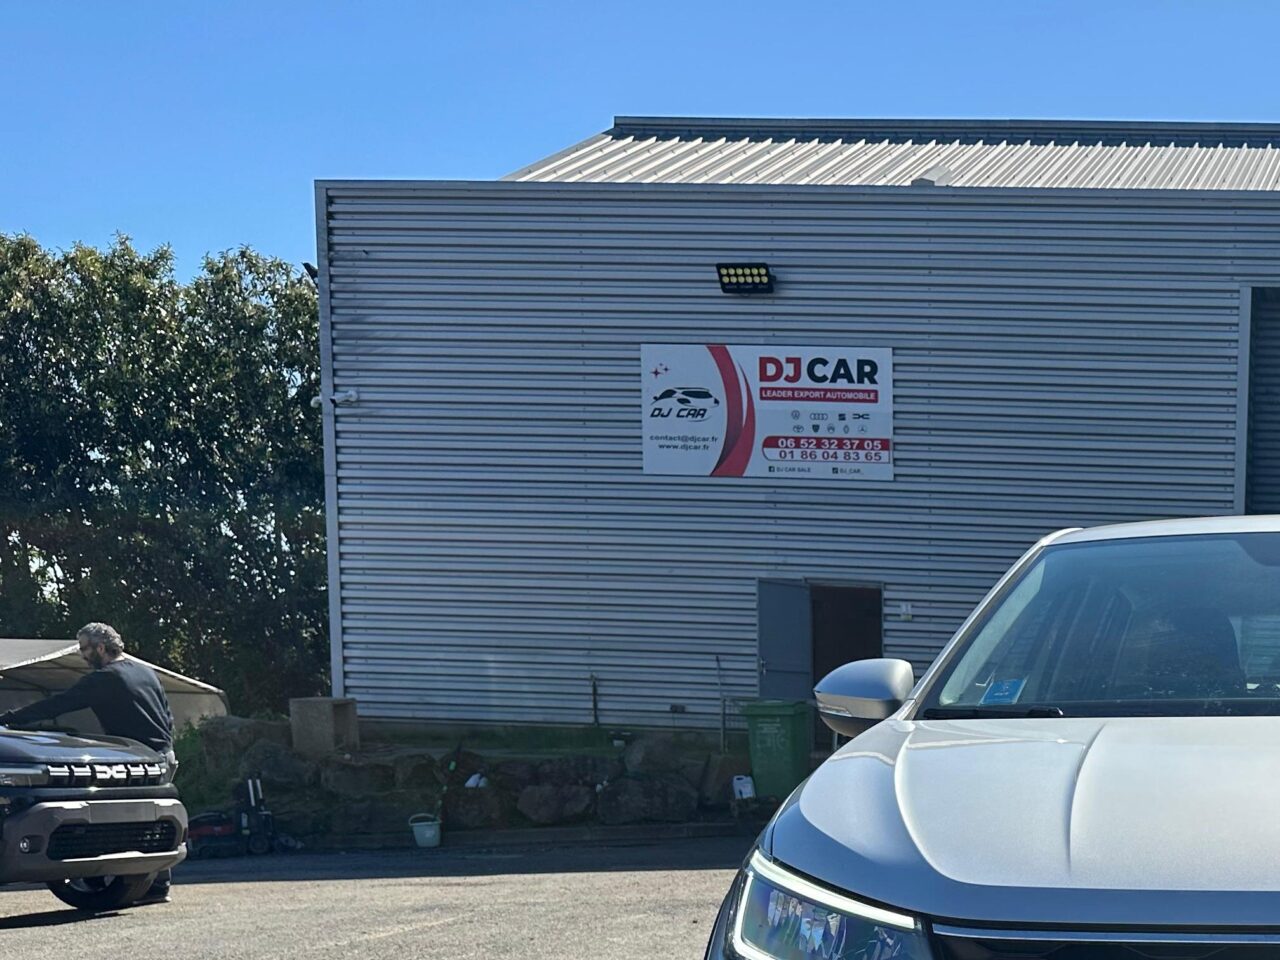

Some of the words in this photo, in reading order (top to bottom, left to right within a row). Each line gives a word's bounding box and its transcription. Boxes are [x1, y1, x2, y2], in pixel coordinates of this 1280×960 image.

[759, 356, 801, 383] DJ
[806, 357, 879, 385] CAR
[762, 390, 793, 398] LEADER
[794, 391, 825, 399] EXPORT
[826, 391, 876, 400] AUTOMOBILE
[650, 407, 673, 418] DJ
[676, 408, 708, 419] CAR
[649, 434, 719, 443] contact@djcar.fr
[778, 438, 796, 448] 06
[800, 438, 817, 449] 52
[821, 439, 838, 449] 32
[842, 440, 860, 450] 37
[864, 440, 882, 450] 05
[658, 443, 710, 451] www.djcar.fr
[779, 450, 795, 460] 01
[800, 450, 817, 460] 86
[821, 451, 839, 460] 04
[843, 451, 860, 461] 83
[864, 452, 882, 461] 65
